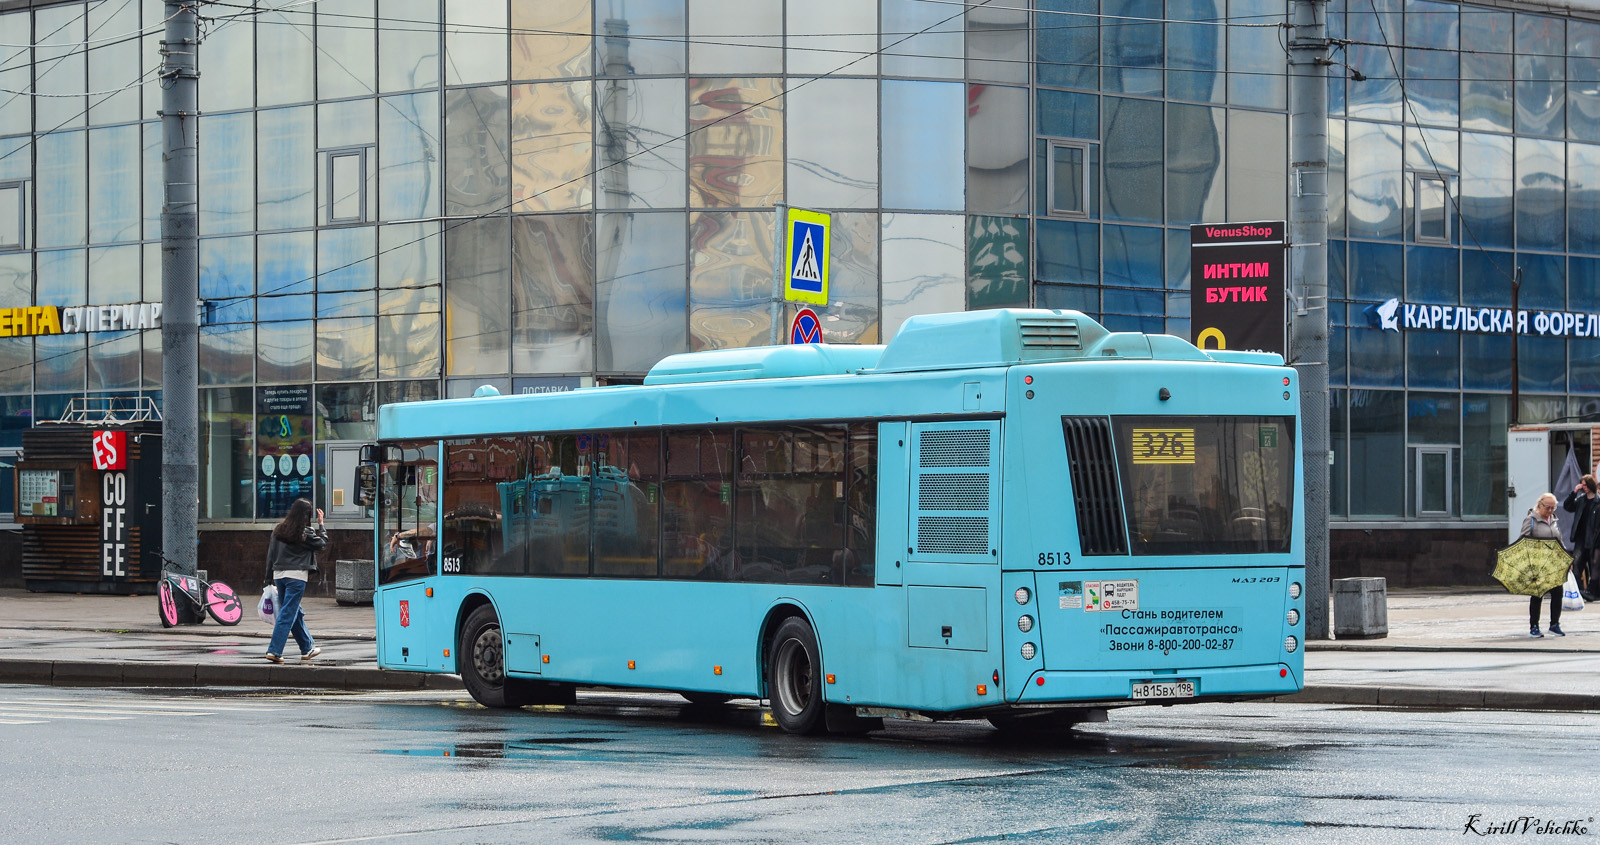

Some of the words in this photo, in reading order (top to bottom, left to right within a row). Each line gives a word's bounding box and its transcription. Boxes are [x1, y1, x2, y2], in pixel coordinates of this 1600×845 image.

[1205, 225, 1273, 238] VenusShop
[1203, 262, 1269, 279] ИНТИМ
[1206, 286, 1268, 303] БУТИК
[62, 302, 203, 334] СУПЕРМАР
[1404, 304, 1528, 333] КАРЕЛЬСКАЯ
[1534, 311, 1600, 337] ФОРЕЛ
[93, 430, 117, 470] ES
[1141, 432, 1185, 458] 326
[443, 558, 461, 573] 8513
[1038, 552, 1071, 566] 8513
[1121, 609, 1158, 620] Стань
[1161, 609, 1224, 621] водителем
[1100, 624, 1243, 637] «Пассажиравтотранса»
[1109, 639, 1145, 651] Звони
[1148, 638, 1234, 651] 8-800-200-02-87
[1177, 683, 1192, 693] 198
